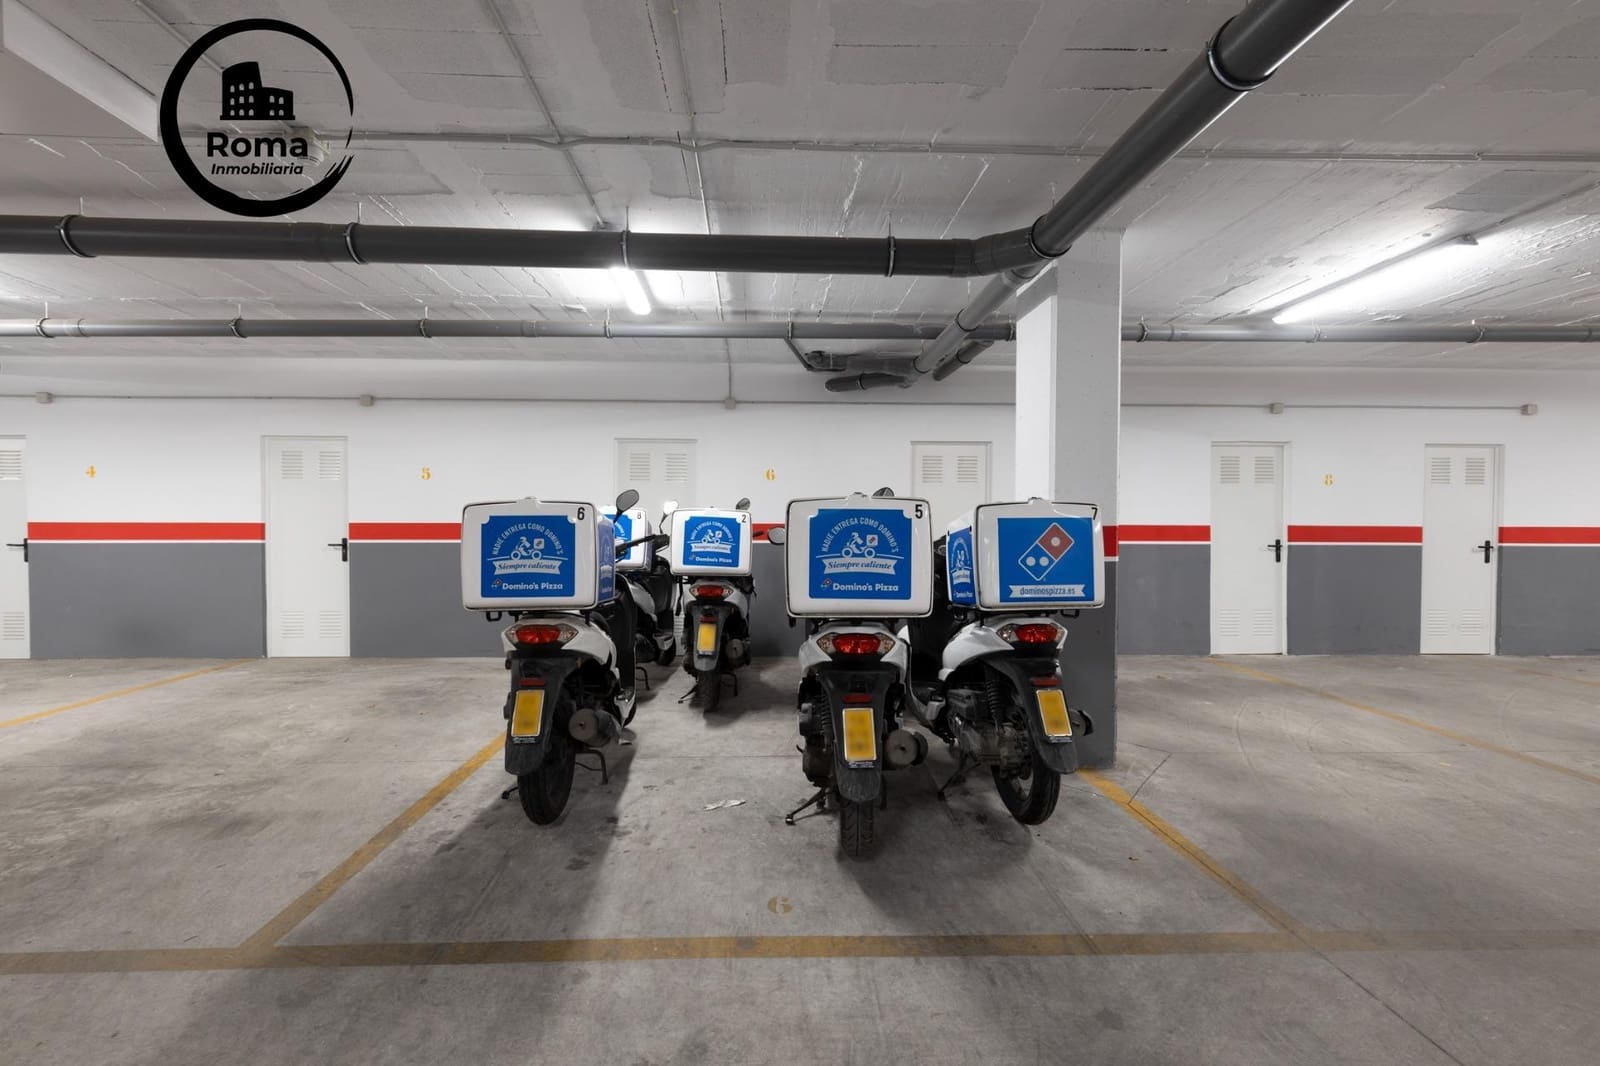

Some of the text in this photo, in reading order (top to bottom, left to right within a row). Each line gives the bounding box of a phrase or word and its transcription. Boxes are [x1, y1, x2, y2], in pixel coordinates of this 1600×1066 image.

[85, 465, 96, 479] 4
[421, 467, 432, 481] 5
[765, 468, 776, 481] 6
[1323, 474, 1334, 487] 8
[577, 507, 585, 520] 6
[915, 504, 923, 519] 5
[1091, 507, 1098, 520] 7
[741, 514, 747, 523] 2
[501, 523, 527, 539] ENTREGA
[527, 523, 545, 533] COMO
[821, 517, 899, 553] NADIE ENTREGA COMO DOMINO'S
[498, 562, 557, 571] Siempre caliente
[827, 560, 892, 570] Siempre caliente
[502, 582, 563, 590] Domino's Pizza
[832, 582, 899, 591] Domino's Pizza
[1019, 587, 1076, 597] dominospizza.es
[767, 895, 793, 915] 6
